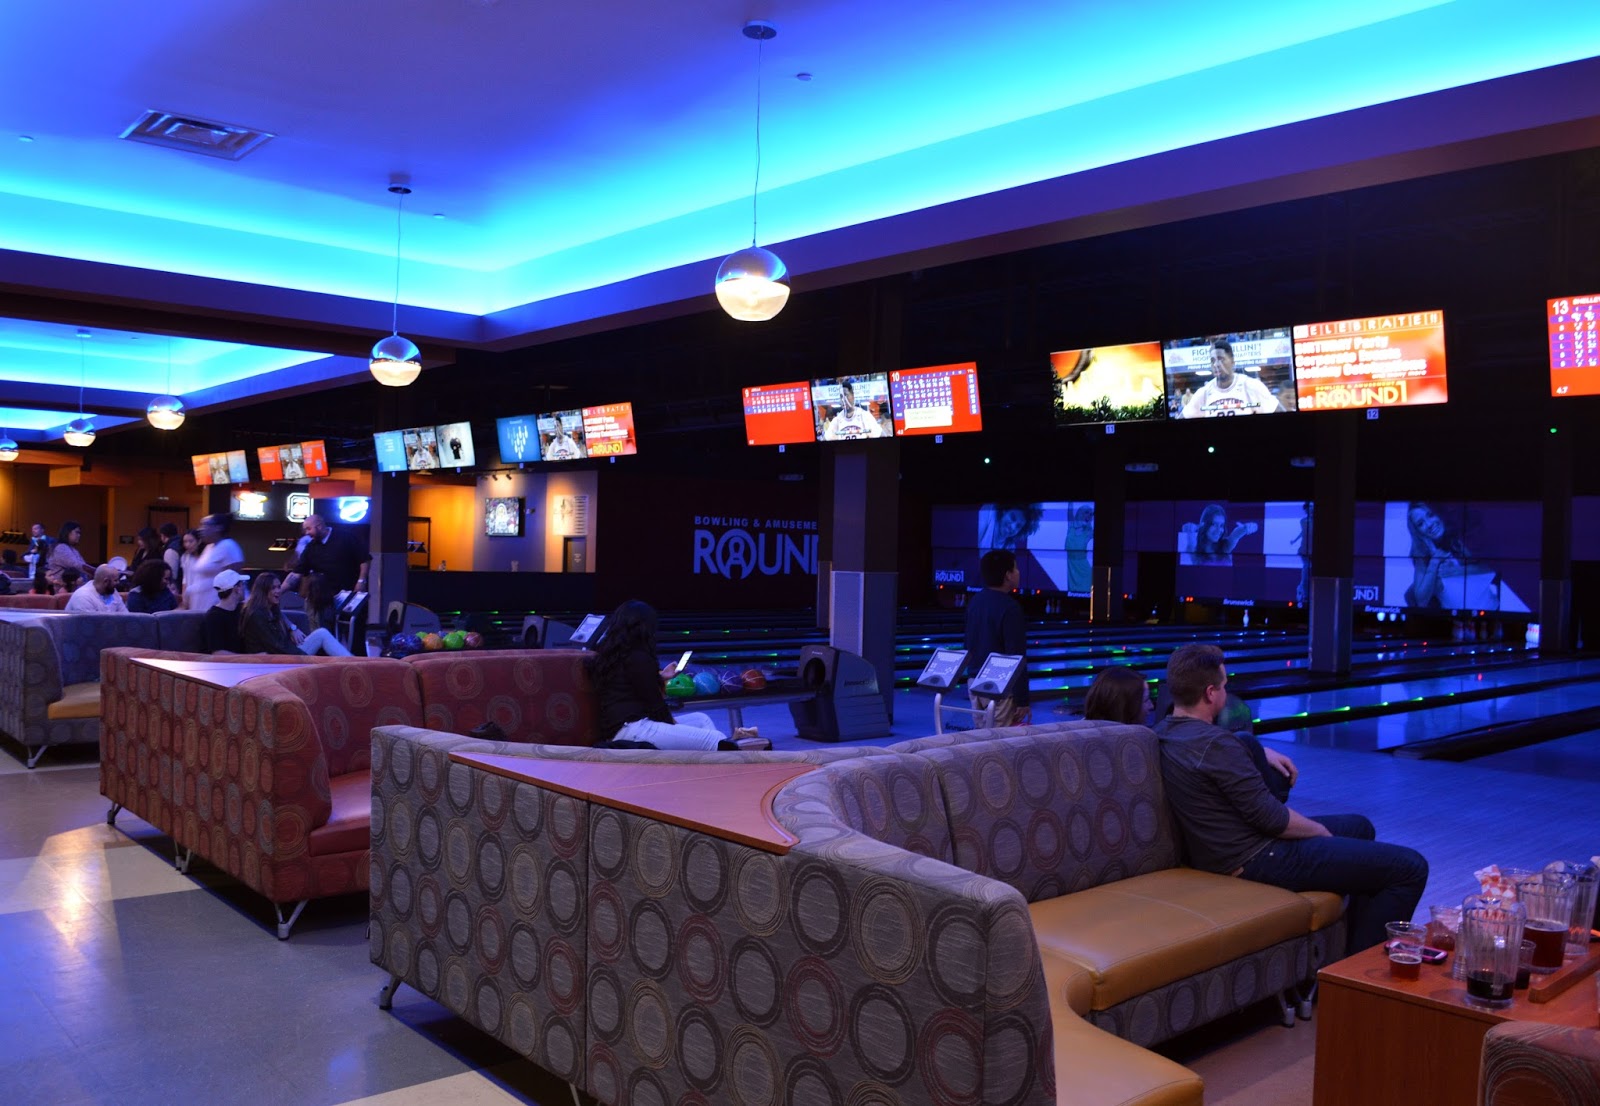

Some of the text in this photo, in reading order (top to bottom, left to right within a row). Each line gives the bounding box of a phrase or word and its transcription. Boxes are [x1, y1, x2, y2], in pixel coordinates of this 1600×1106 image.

[1552, 300, 1569, 315] 13
[891, 371, 900, 382] 10
[1367, 410, 1378, 419] 12
[1106, 425, 1115, 433] 11
[694, 515, 818, 530] BOWLING & AMUSEME
[693, 528, 819, 579] ROUN
[1353, 586, 1379, 601] UND1
[1223, 598, 1255, 607] Brunswick
